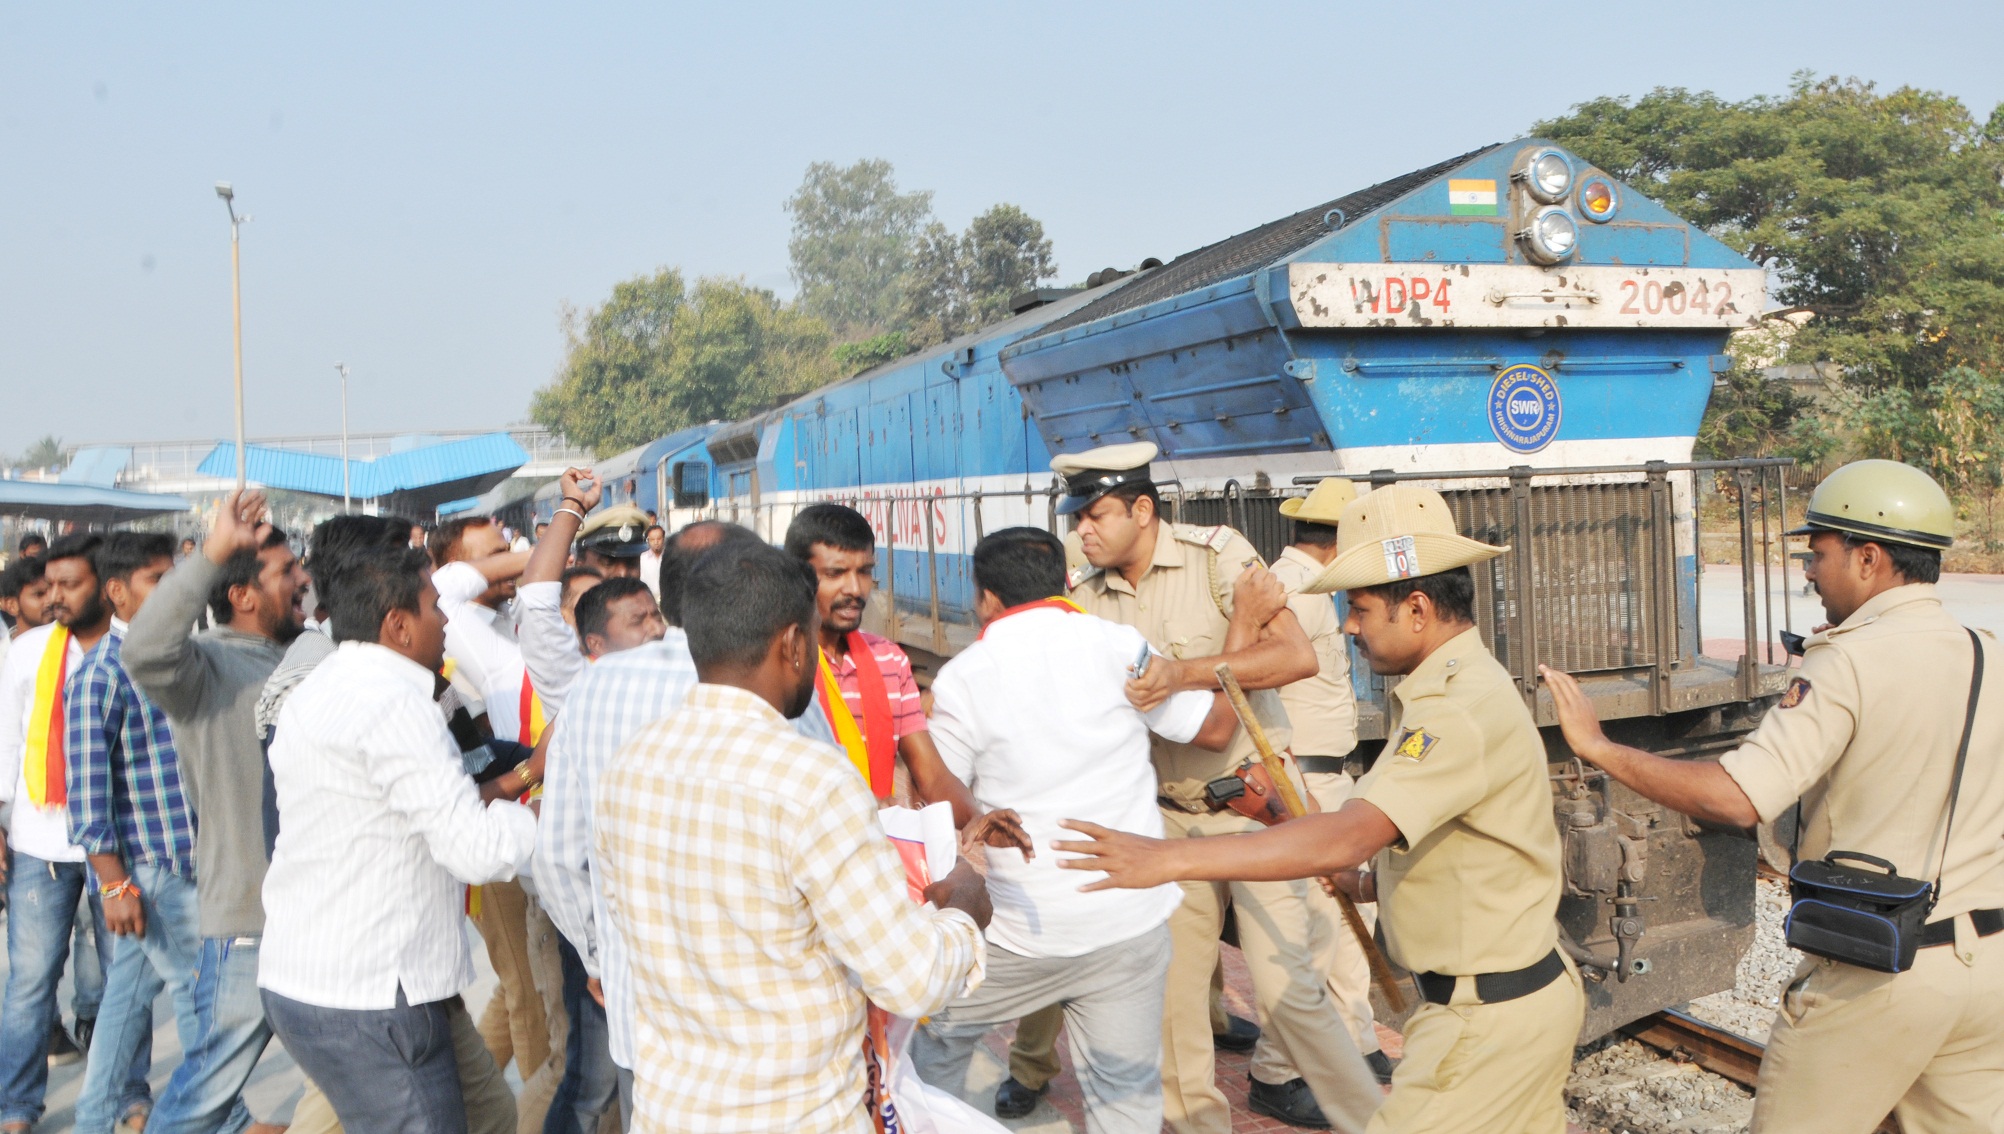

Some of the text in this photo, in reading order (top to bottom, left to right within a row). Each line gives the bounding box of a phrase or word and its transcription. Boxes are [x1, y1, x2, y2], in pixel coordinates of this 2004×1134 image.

[1349, 277, 1451, 314] WDP4
[1619, 279, 1733, 316] 20042
[1496, 371, 1555, 401] DIESEL SHED
[1511, 400, 1540, 415] SWR
[1495, 411, 1556, 445] KRISHNARAJAPURAM
